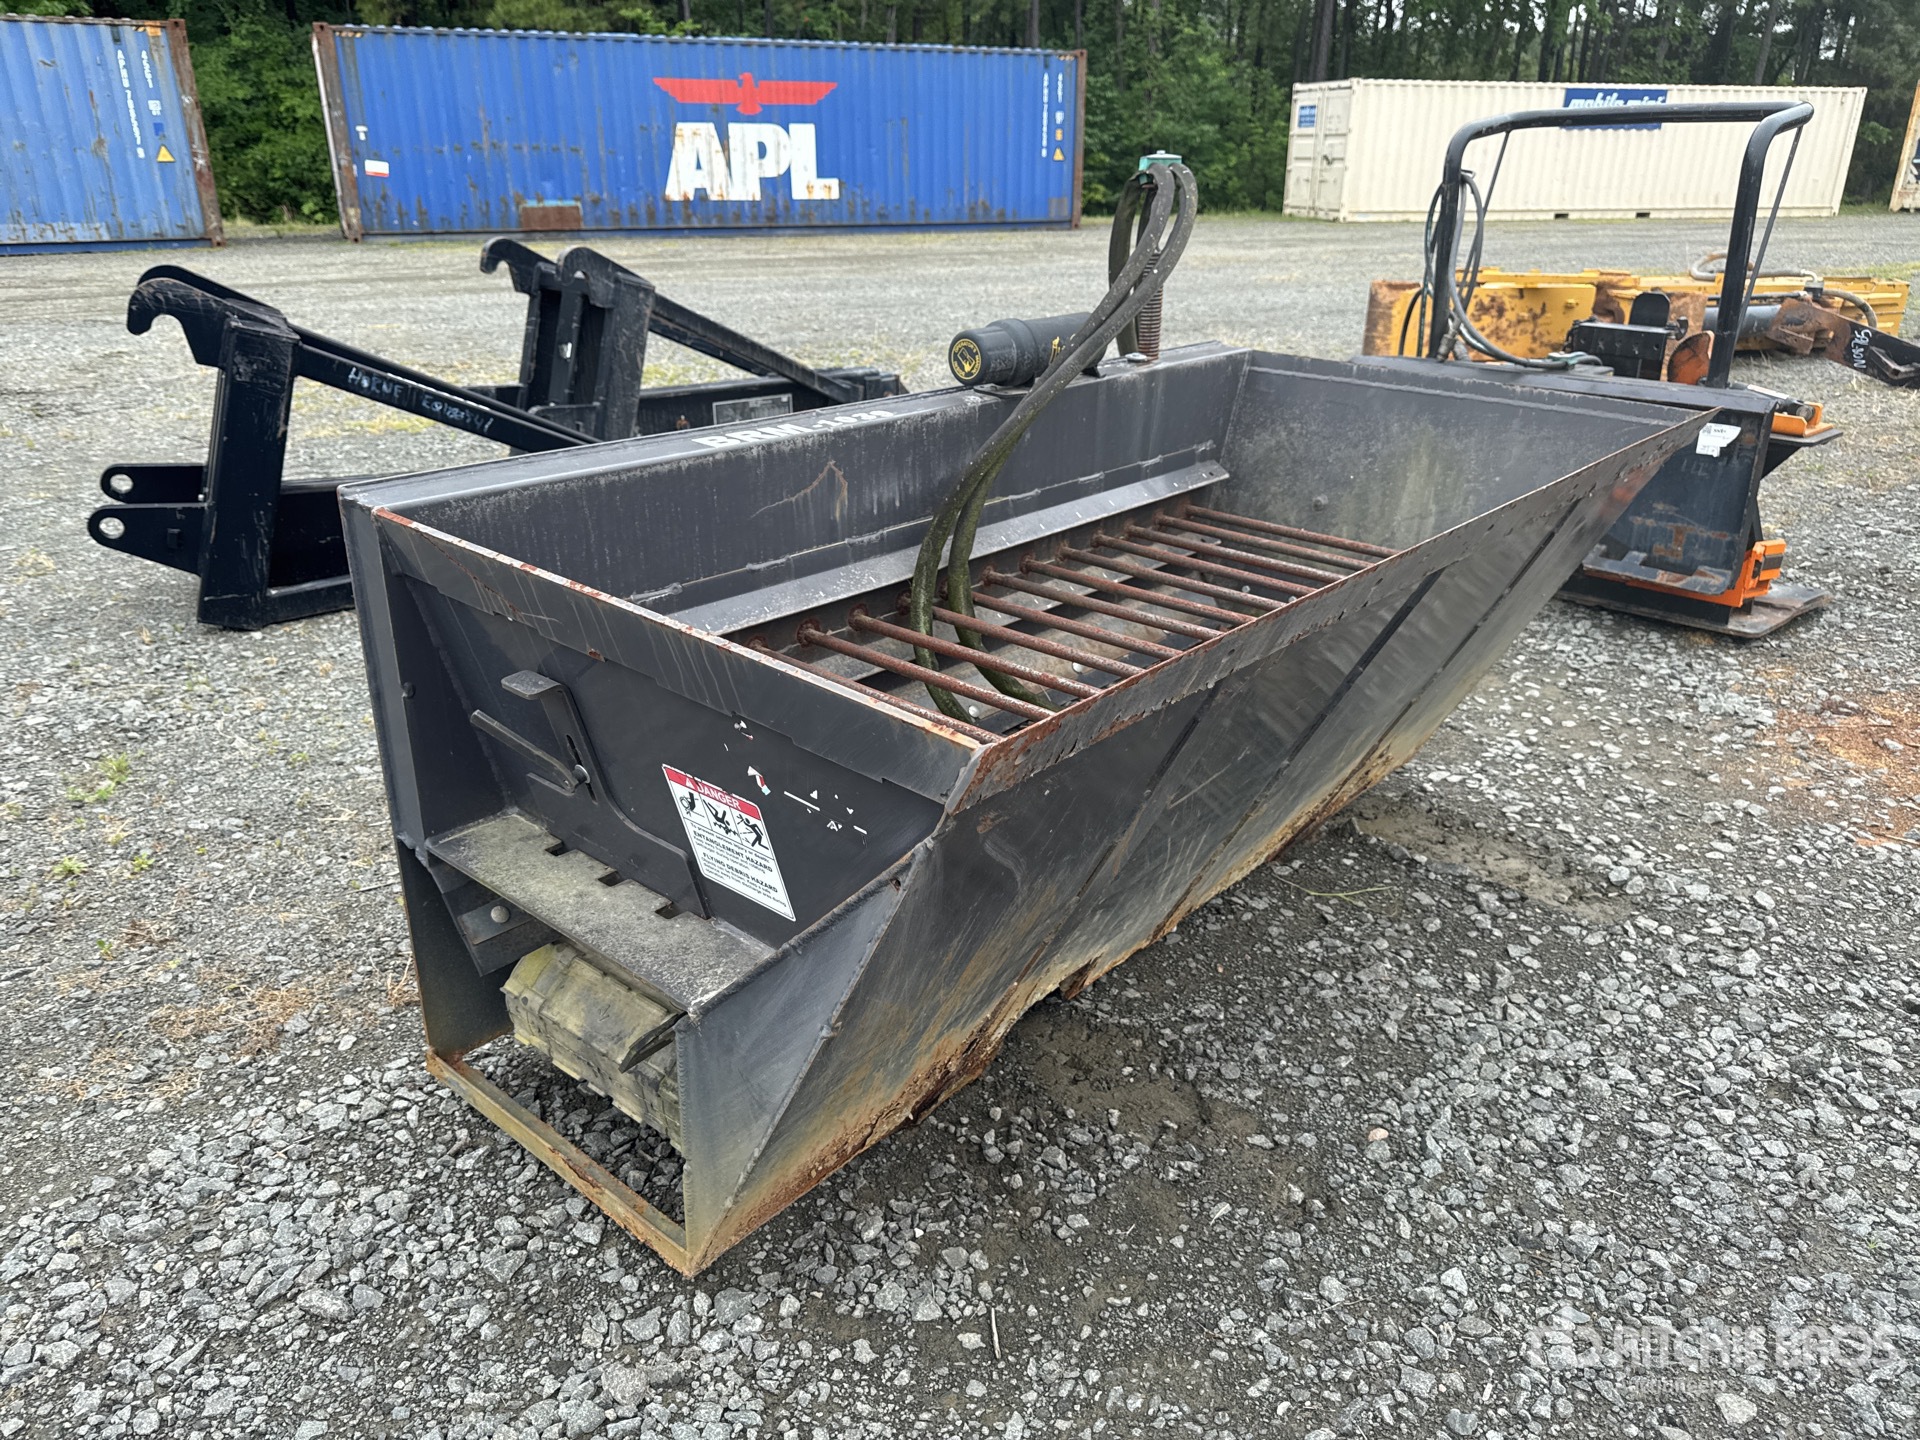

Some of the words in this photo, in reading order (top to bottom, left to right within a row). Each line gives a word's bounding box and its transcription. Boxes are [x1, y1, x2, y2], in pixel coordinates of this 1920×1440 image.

[665, 122, 840, 201] APL
[694, 781, 741, 810] DANGER
[692, 829, 744, 859] ENTANGLEMENT
[744, 854, 773, 873] HAZARD
[701, 850, 726, 867] FLYING
[725, 862, 750, 880] DEBRIS
[749, 874, 778, 894] HAZARD
